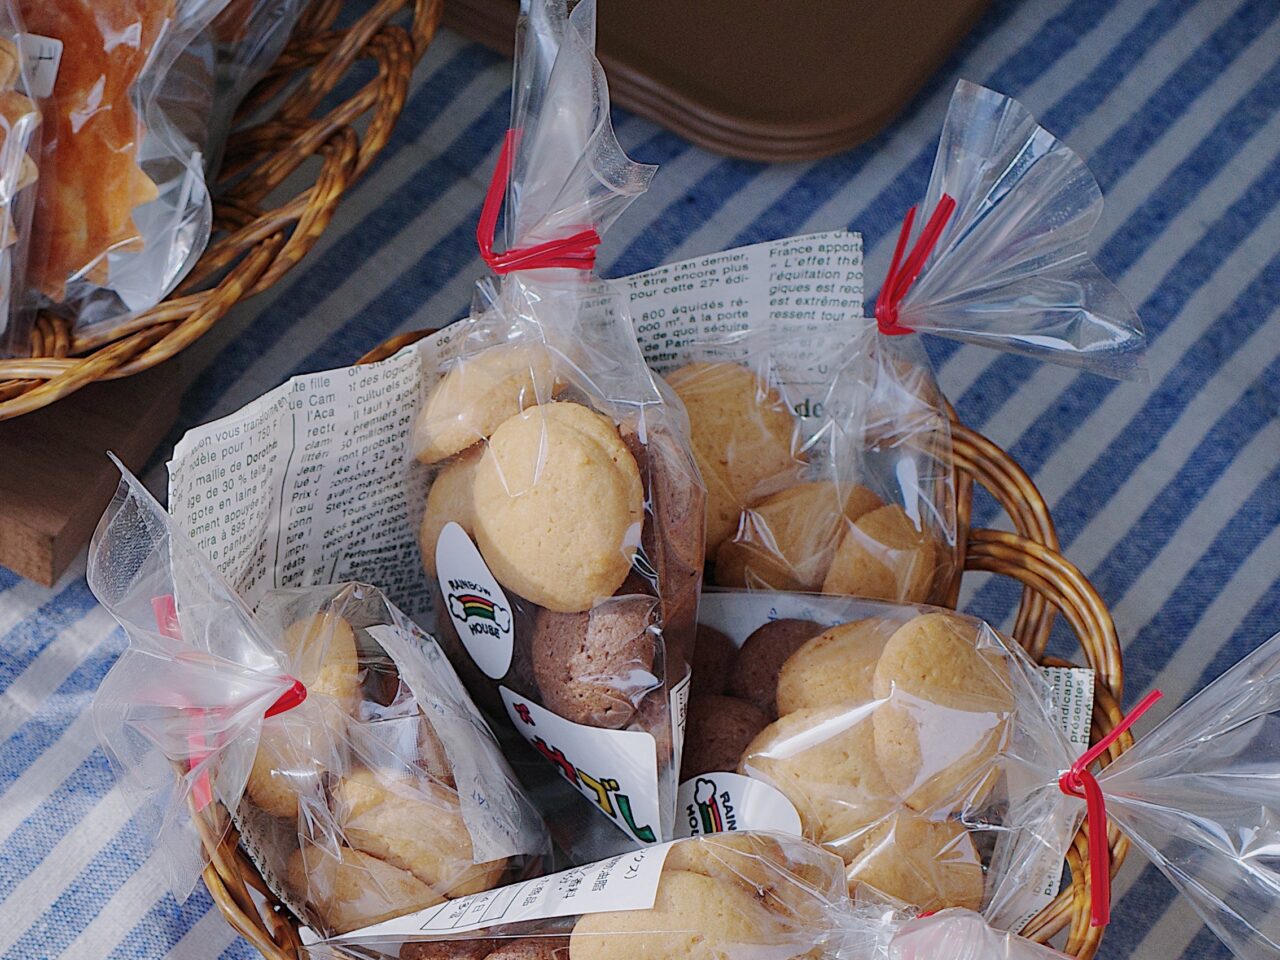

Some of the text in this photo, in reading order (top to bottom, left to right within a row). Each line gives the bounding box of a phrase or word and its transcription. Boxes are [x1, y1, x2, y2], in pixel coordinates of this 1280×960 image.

[770, 243, 812, 257] France
[674, 264, 748, 281] encore plus
[770, 269, 840, 281] l'équitation
[664, 284, 693, 294] cette
[770, 283, 835, 295] giques est
[770, 297, 788, 306] est
[642, 301, 723, 321] 800 équidés
[717, 311, 748, 321] porte
[770, 310, 816, 321] ressent
[673, 328, 697, 338] quoi
[447, 579, 493, 597] RAINBOW
